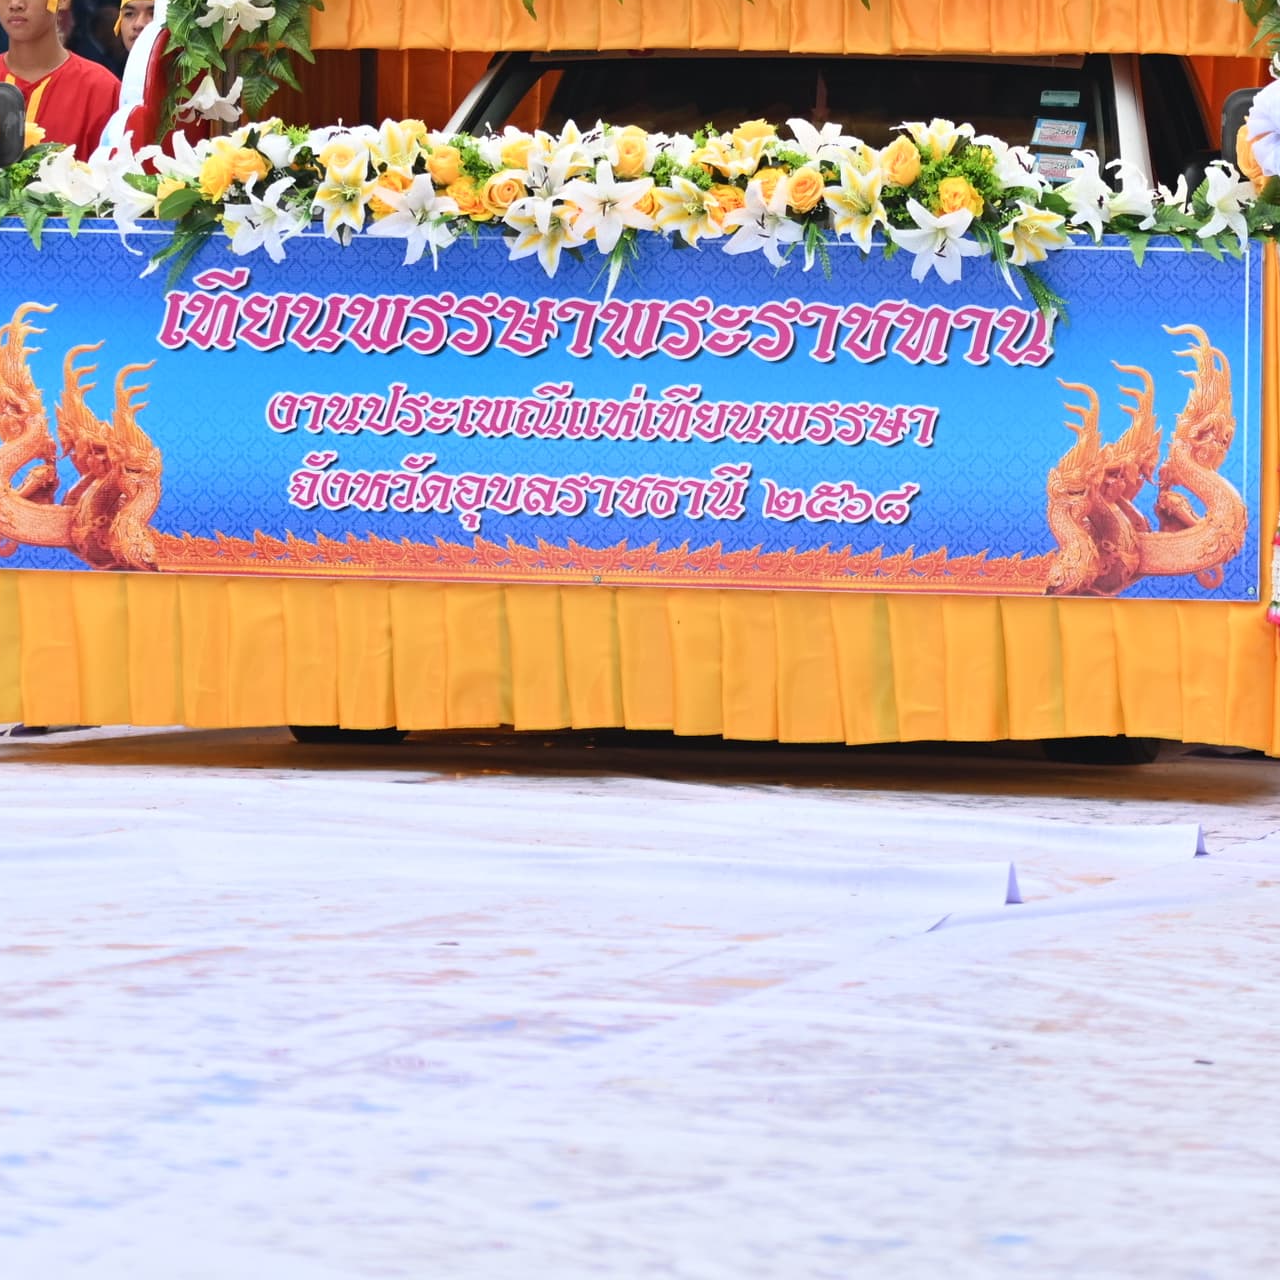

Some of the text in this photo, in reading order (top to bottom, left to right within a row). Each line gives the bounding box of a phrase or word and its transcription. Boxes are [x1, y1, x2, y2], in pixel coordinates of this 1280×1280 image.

[158, 268, 1053, 365] เทียนพรรษาพระราชทาน
[266, 382, 937, 446] งานประเพณีแห่เทียนพรรษา
[289, 451, 919, 530] จังหวัดอุบลราชธานี ๒๕๖๘
